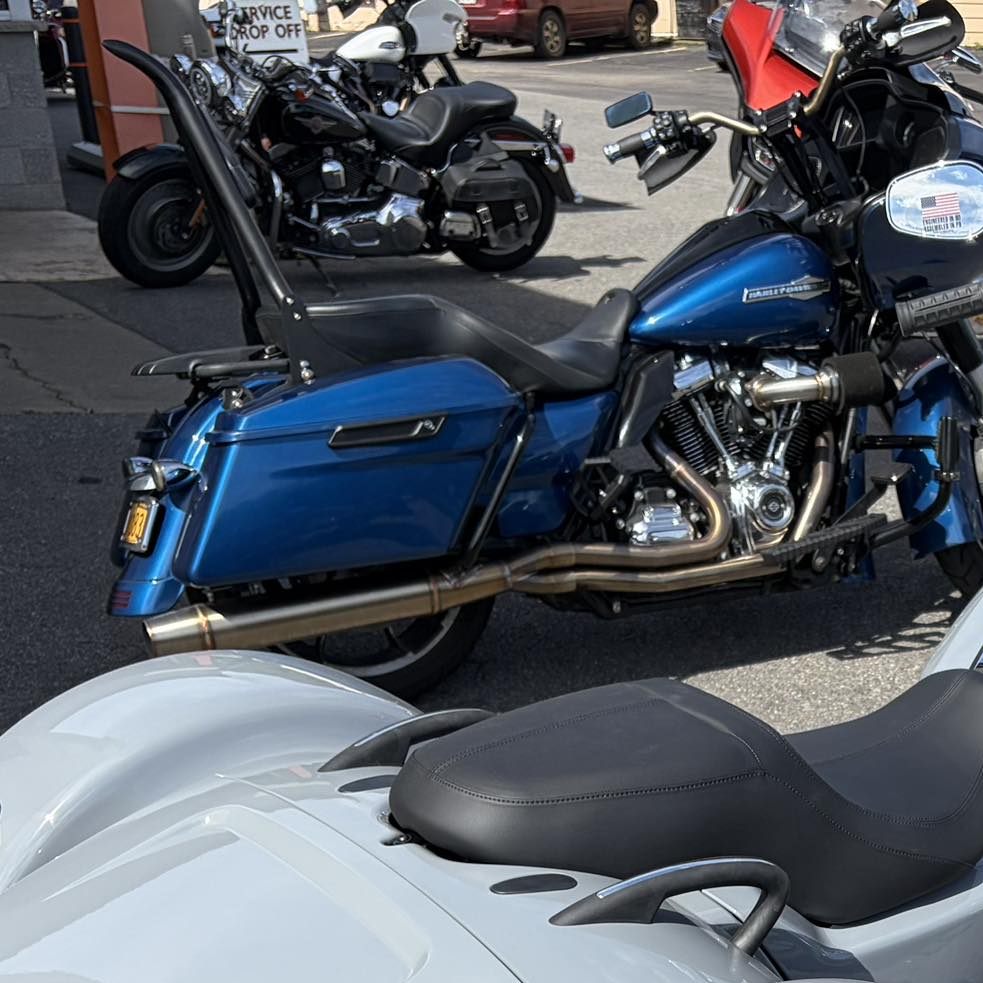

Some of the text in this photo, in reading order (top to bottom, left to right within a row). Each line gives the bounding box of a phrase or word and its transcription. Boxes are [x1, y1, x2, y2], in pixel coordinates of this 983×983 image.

[239, 5, 292, 21] ERVICE
[231, 24, 301, 40] DROP OFF
